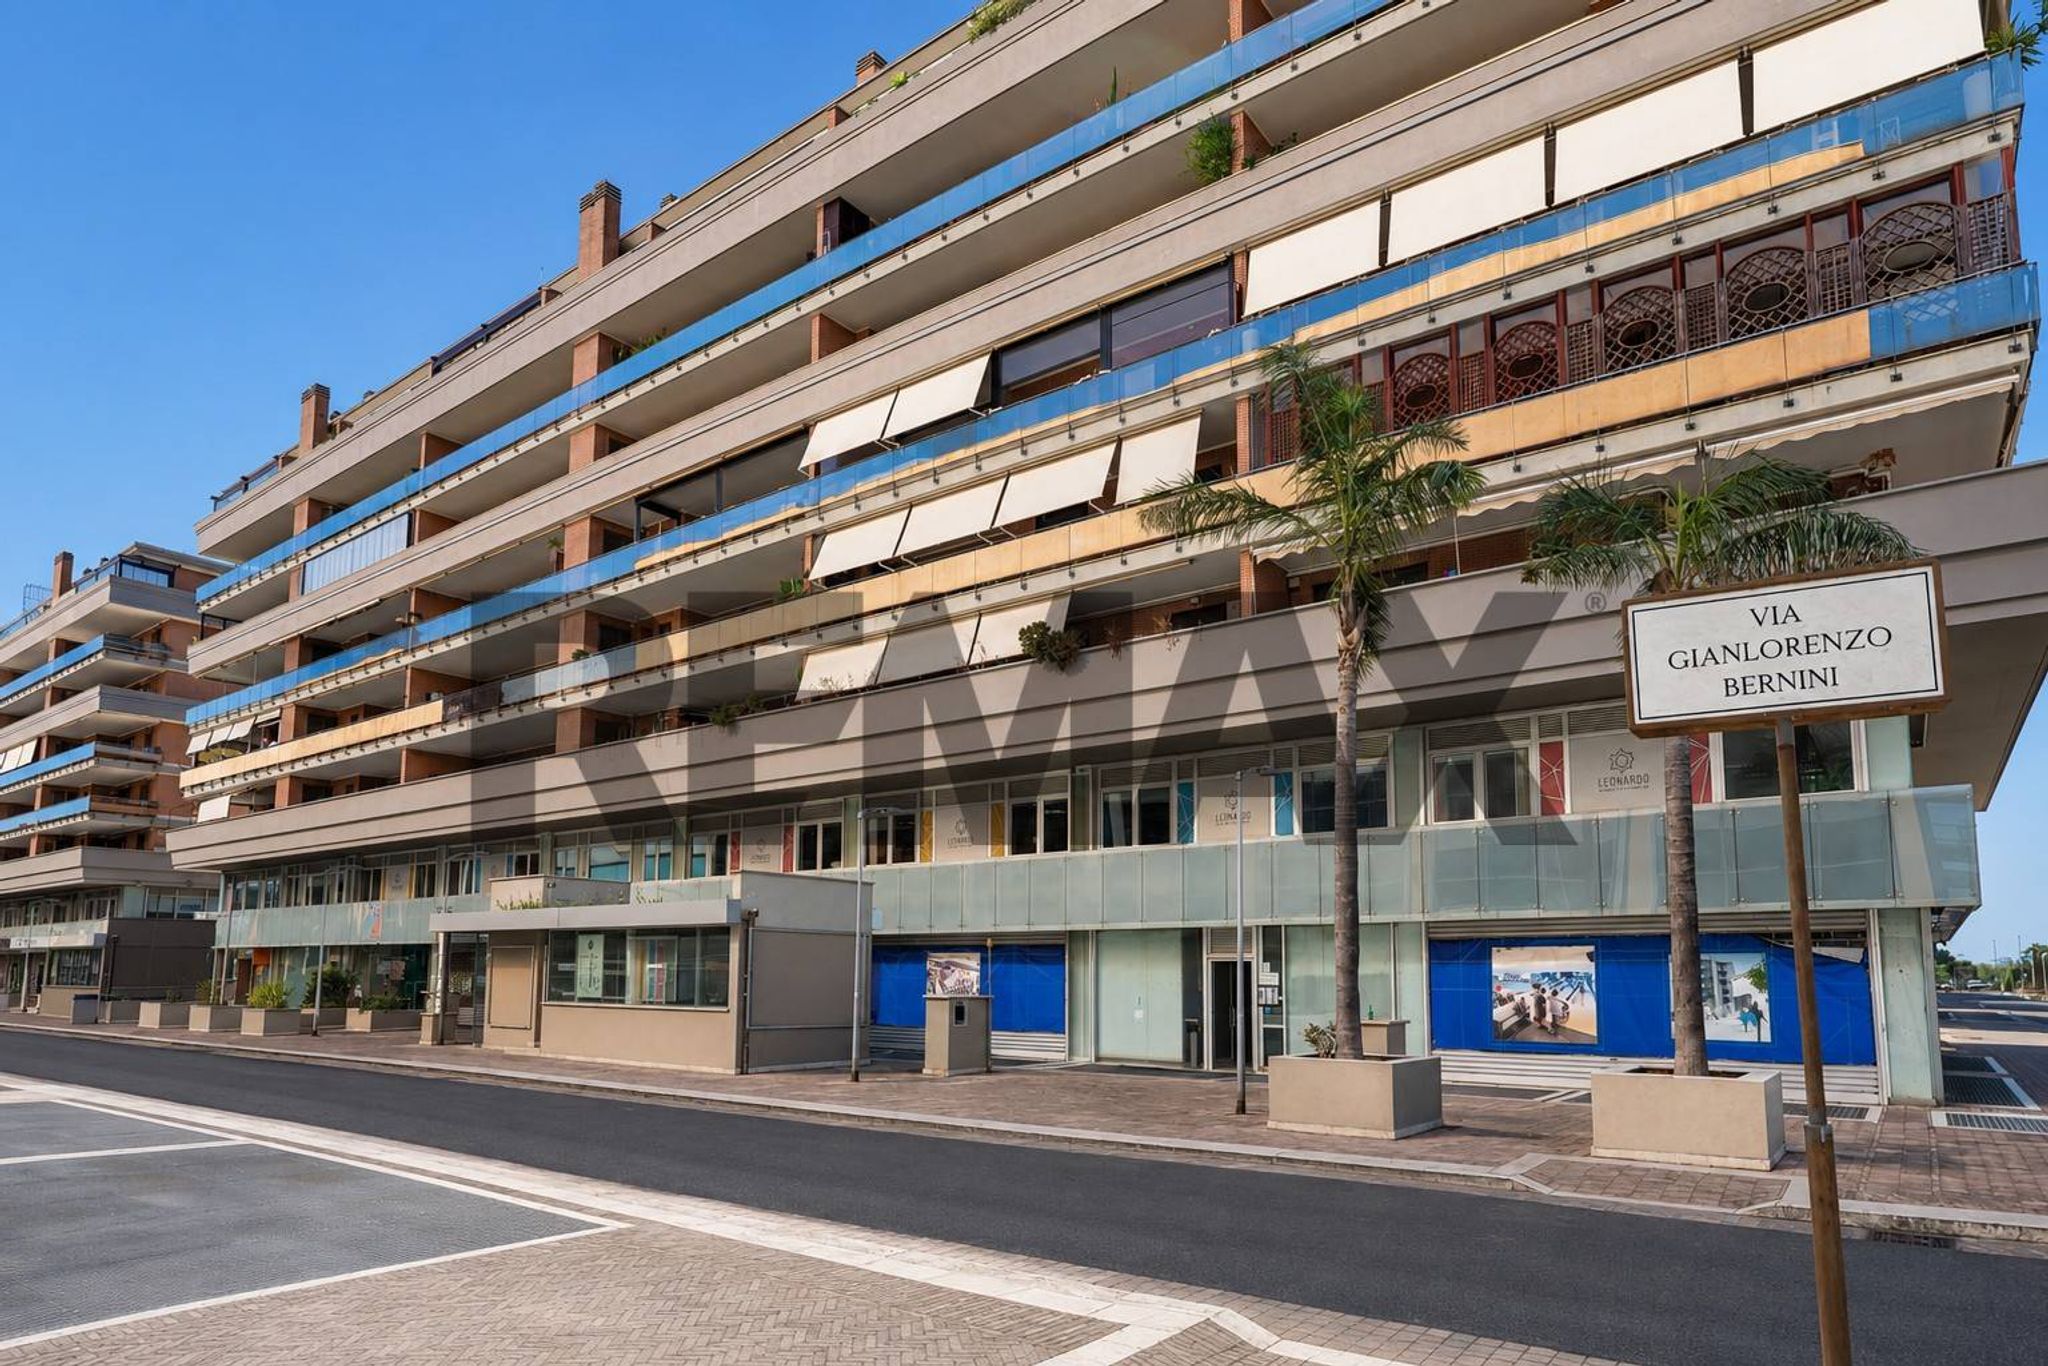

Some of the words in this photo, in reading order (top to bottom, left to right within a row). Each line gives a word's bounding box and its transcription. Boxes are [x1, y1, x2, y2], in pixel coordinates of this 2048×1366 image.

[1750, 604, 1800, 627] VIA
[1668, 626, 1892, 670] GIANLORENZO
[1723, 667, 1839, 698] BERNINI
[1598, 773, 1649, 788] LEONARDO
